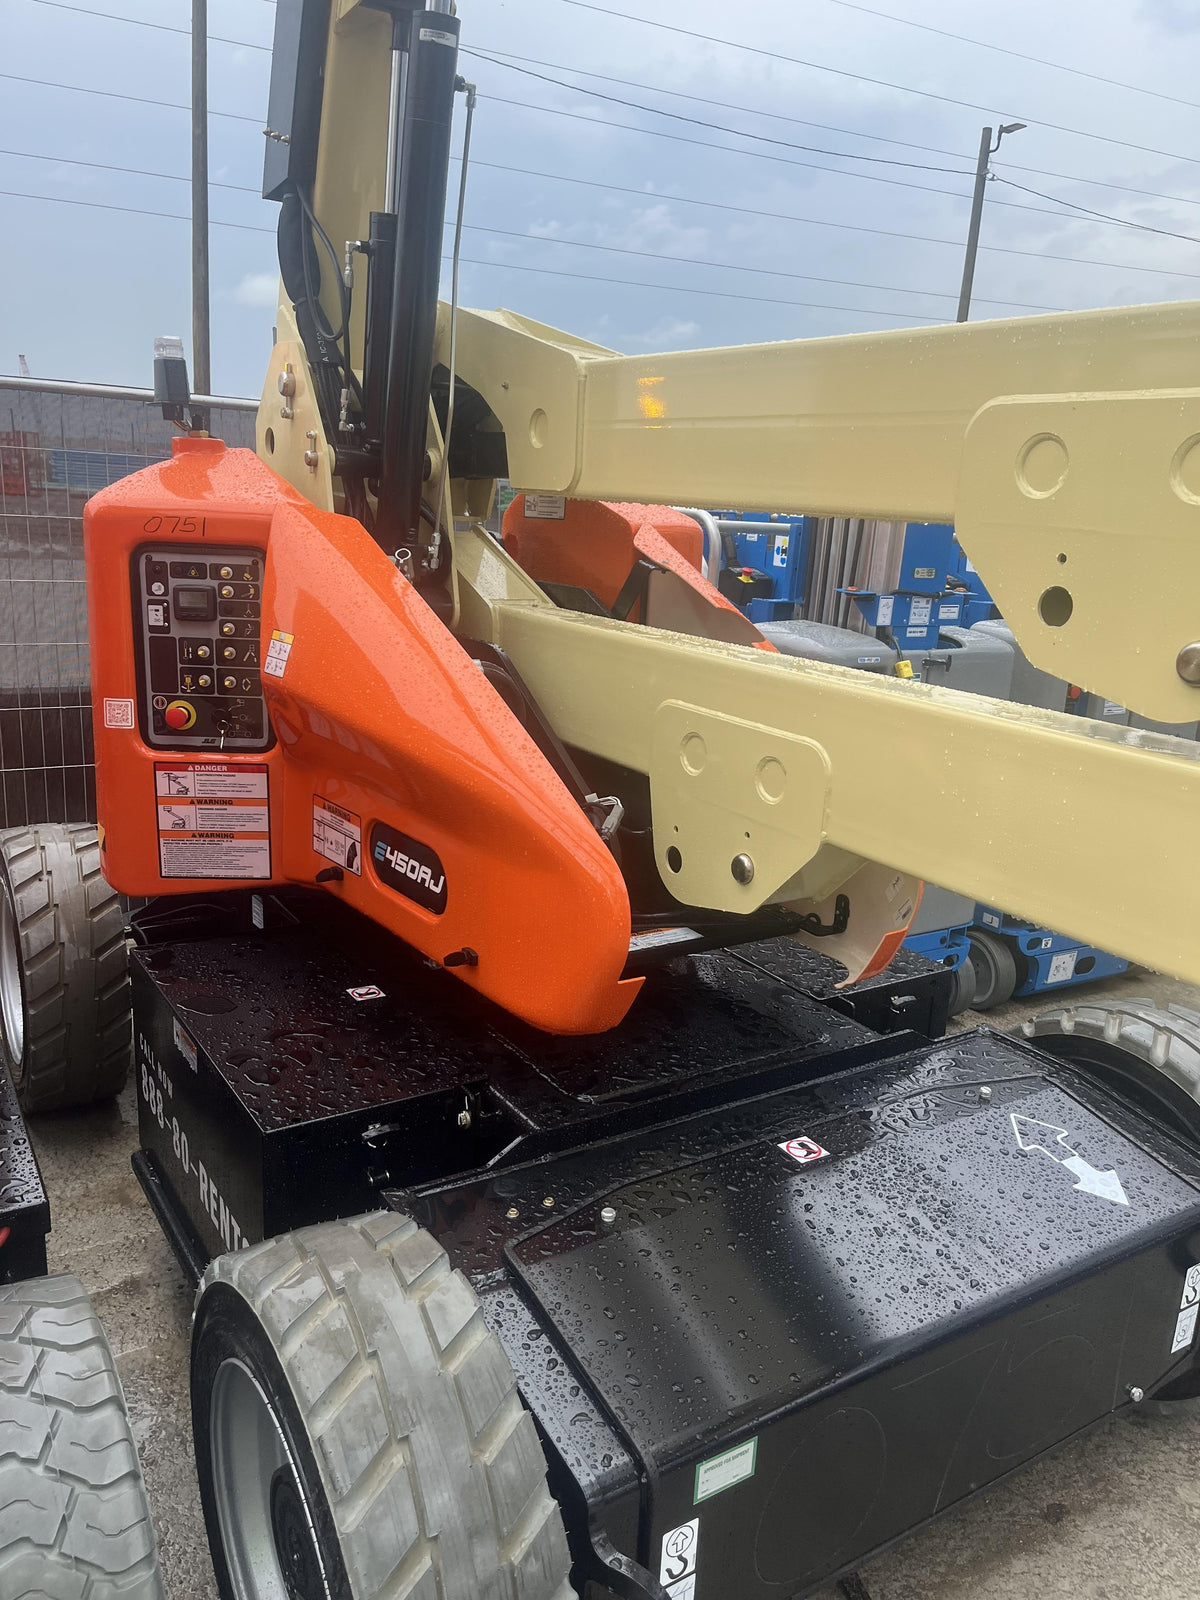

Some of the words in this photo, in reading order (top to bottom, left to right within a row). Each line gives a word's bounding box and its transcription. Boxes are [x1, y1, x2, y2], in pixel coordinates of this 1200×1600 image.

[143, 515, 206, 537] 0751
[327, 803, 351, 822] WARNING
[374, 840, 445, 894] E450AJ
[139, 1032, 156, 1070] CALL
[157, 1061, 173, 1099] NOW
[141, 1062, 250, 1252] 888-80-RENT
